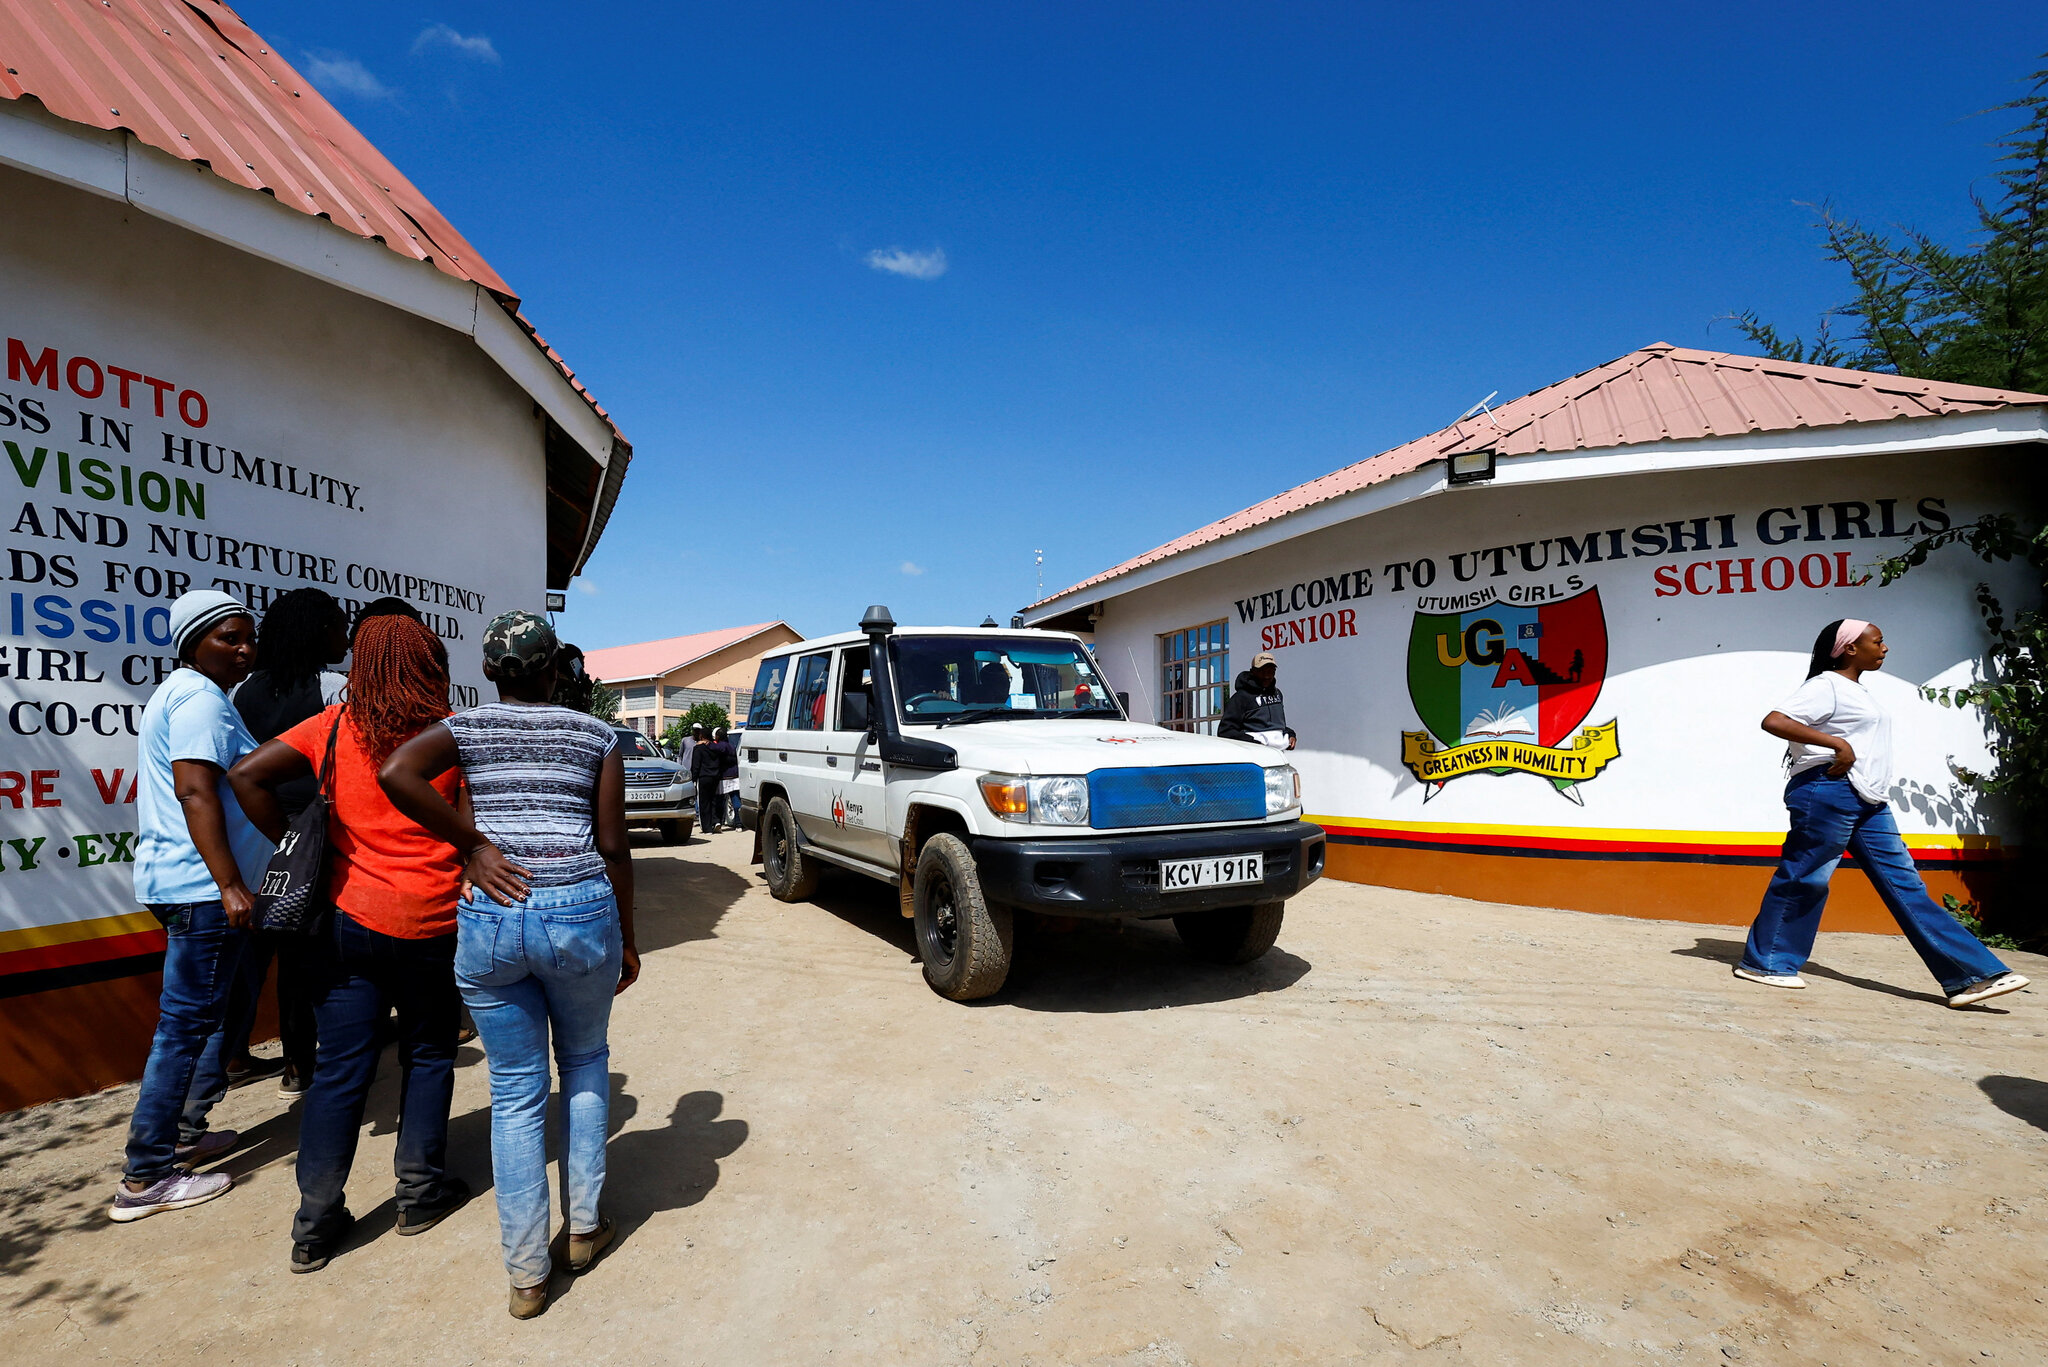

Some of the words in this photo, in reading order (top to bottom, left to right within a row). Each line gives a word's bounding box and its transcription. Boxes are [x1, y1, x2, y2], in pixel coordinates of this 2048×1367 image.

[8, 337, 208, 428] MOTTO
[2, 440, 205, 520] VISION
[78, 411, 134, 453] IN
[161, 432, 364, 512] HUMILITY.
[0, 548, 78, 588] DS
[103, 560, 191, 600] FOR
[10, 502, 128, 547] AND
[148, 523, 338, 585] NURTURE
[346, 563, 485, 614] COMPETENCY
[1235, 569, 1373, 624] WELCOME
[1384, 558, 1436, 592] TO
[1449, 514, 1738, 582] UTUMISHI
[1756, 497, 1951, 545] GIRLS
[1417, 585, 1497, 611] UTUMISHI
[1508, 574, 1584, 602] GIRLS
[1261, 608, 1358, 651] SENIOR
[1654, 551, 1872, 598] SCHOOL
[1436, 618, 1537, 688] UGA
[1423, 746, 1493, 776] GREATNESS
[1496, 746, 1509, 762] IN
[1514, 747, 1588, 774] HUMILITY
[845, 799, 863, 816] Kenya
[73, 831, 139, 868] EX
[1165, 864, 1202, 887] KCV
[1213, 859, 1258, 883] 191R
